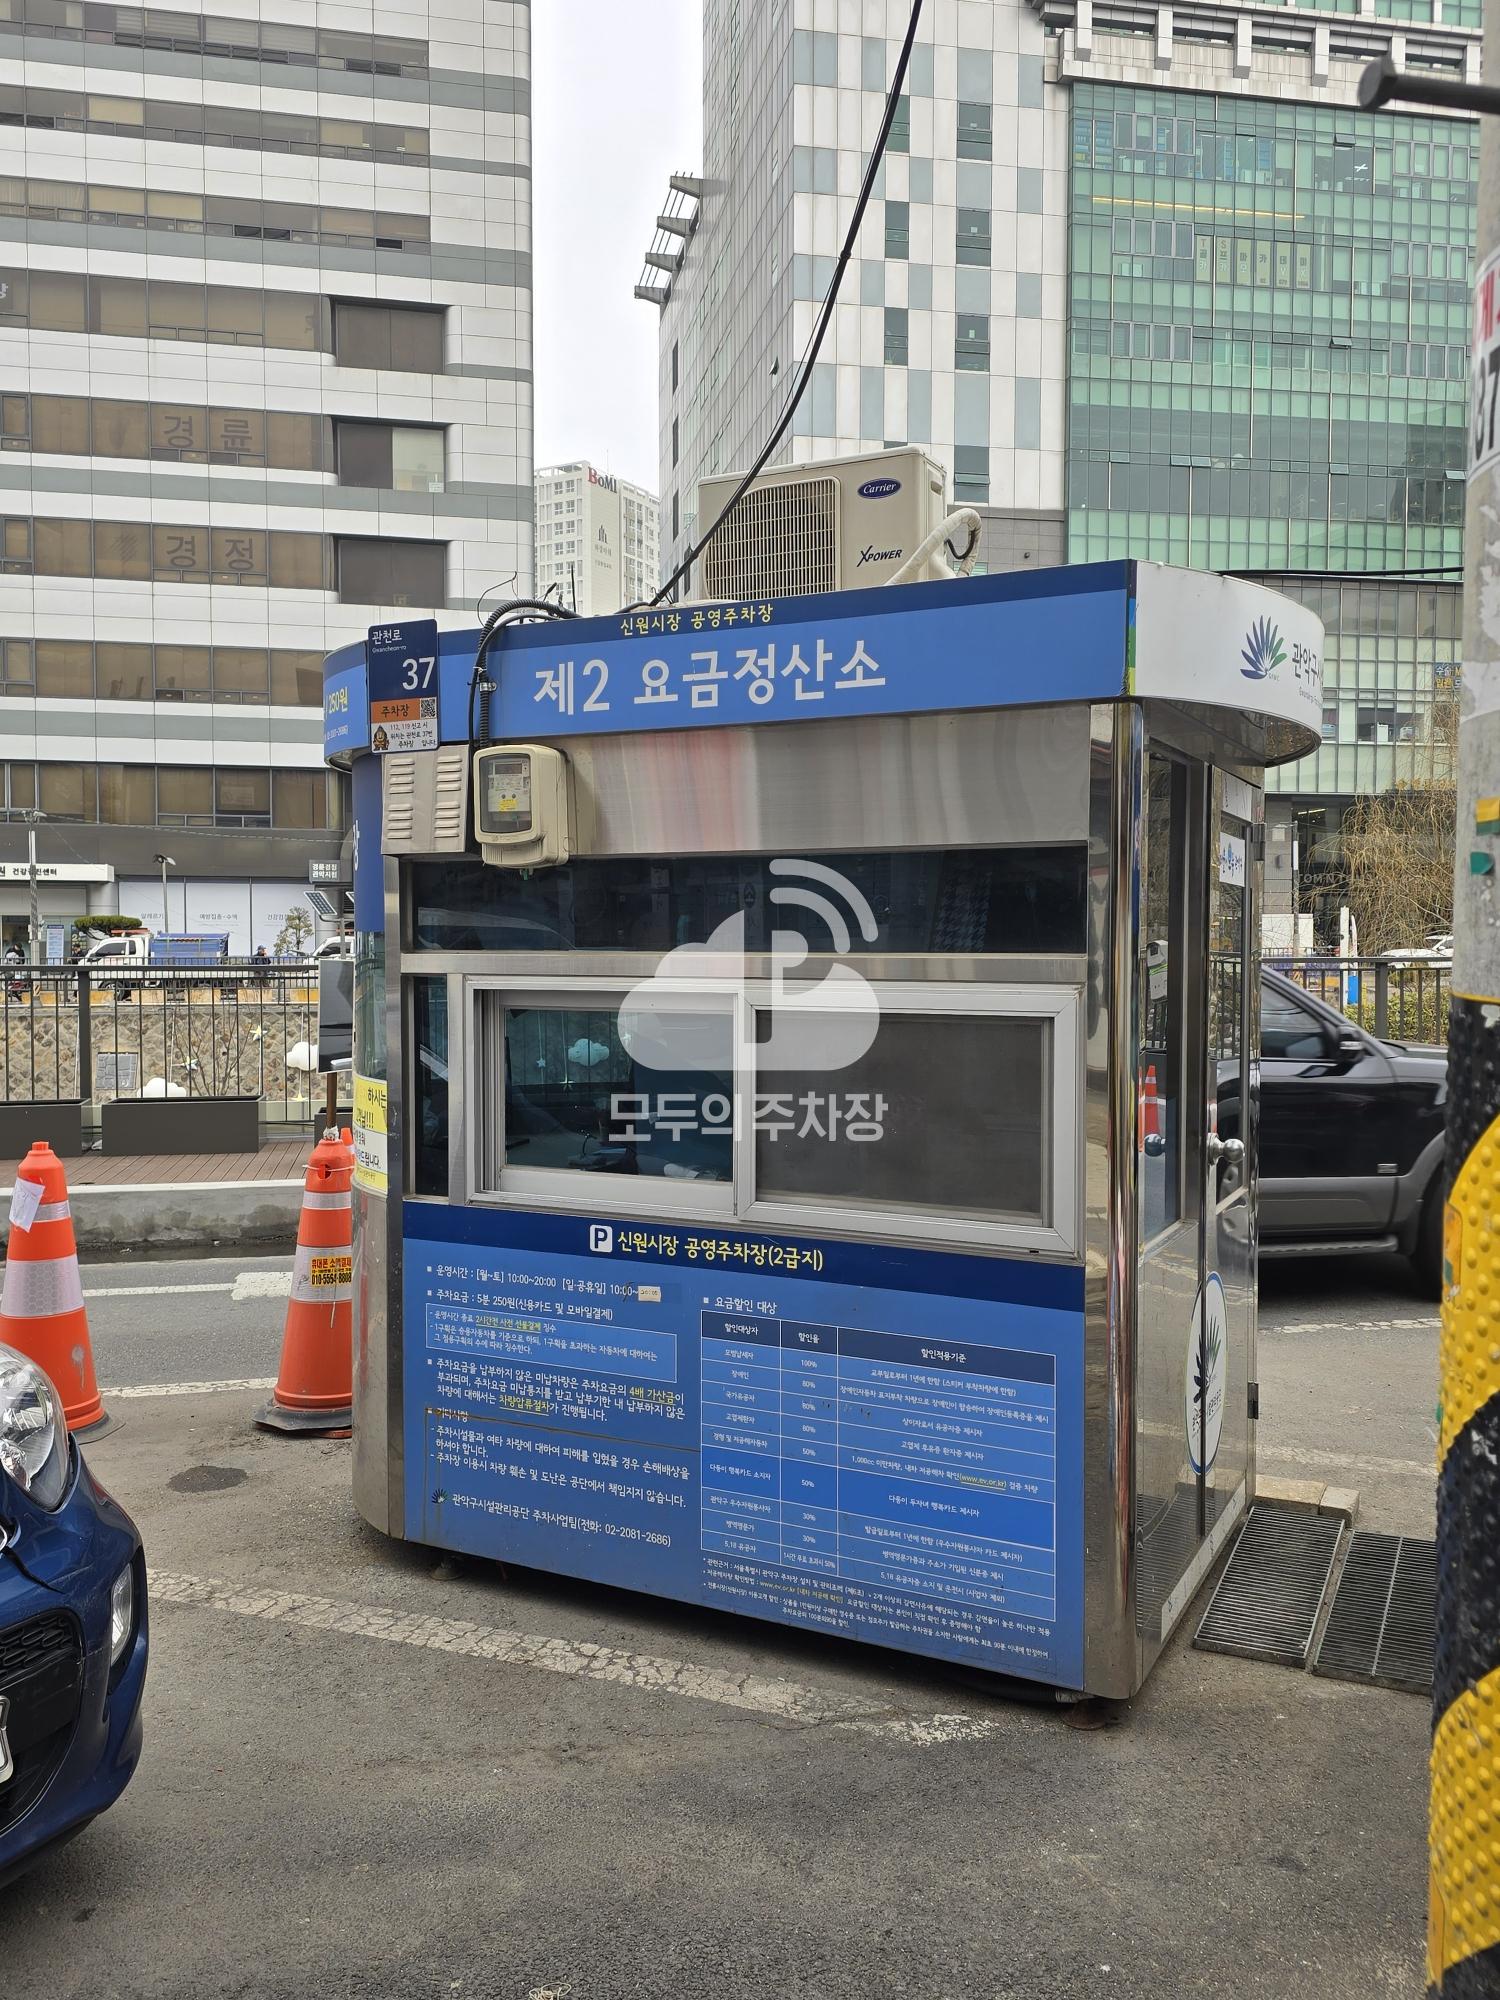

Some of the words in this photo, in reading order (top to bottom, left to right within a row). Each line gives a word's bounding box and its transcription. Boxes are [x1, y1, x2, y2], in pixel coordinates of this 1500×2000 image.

[863, 483, 896, 494] Carrier
[620, 617, 681, 637] 신원시장
[690, 602, 774, 630] 공영주차장
[371, 629, 402, 645] 관천로
[402, 657, 435, 690] 37
[534, 659, 610, 715] 제2
[633, 638, 886, 707] 요금정산소
[381, 704, 410, 718] 주차장
[402, 722, 411, 730] 119
[13, 867, 57, 876] 건강진센터
[367, 1086, 387, 1109] 하시는
[618, 1230, 680, 1257] 신원시장
[684, 1235, 824, 1272] 공영주차장(2급지)
[436, 1265, 468, 1278] 운영시간
[477, 1269, 503, 1283] [월~토]
[508, 1273, 556, 1287] 10:00~20:00
[437, 1289, 469, 1303] 주차요금
[477, 1294, 490, 1305] 5분
[493, 1296, 552, 1312] 250원(신용카드
[555, 1303, 563, 1314] 및
[567, 1305, 612, 1320] 모바일결제)
[715, 1297, 752, 1312] 요금할인
[757, 1301, 777, 1314] 대상
[725, 1323, 758, 1335] 할인대상자
[799, 1333, 819, 1343] 할인율
[599, 1345, 627, 1357] 자동차에
[630, 1350, 657, 1361] 대하여는
[921, 1349, 966, 1363] 할인적용기준
[437, 1358, 477, 1374] 주차요금을
[480, 1365, 512, 1379] 납부하지
[516, 1370, 533, 1382] 않은
[536, 1373, 578, 1389] 미납차량은
[582, 1380, 626, 1396] 주차요금의
[630, 1387, 643, 1398] 4배
[648, 1389, 683, 1405] 가산금이
[732, 1370, 749, 1379] 장애인
[437, 1372, 470, 1387] 부과되며,
[474, 1377, 507, 1392] 주차요금
[511, 1383, 552, 1399] 미납통지를
[555, 1389, 572, 1401] 받고
[576, 1392, 611, 1408] 납부기한
[615, 1398, 623, 1409] 내
[627, 1400, 662, 1416] 납부하지
[666, 1406, 685, 1419] 않은
[438, 1385, 461, 1398] 차량에
[465, 1390, 496, 1404] 대해서는
[500, 1395, 558, 1413] 차량압류절차가
[562, 1405, 607, 1421] 진행됩니다.
[436, 1439, 460, 1452] 하셔야
[462, 1443, 488, 1457] 합니다.
[437, 1426, 484, 1443] 주차시설물과
[487, 1435, 503, 1447] 여타
[506, 1438, 531, 1452] 차량에
[535, 1443, 559, 1456] 대하여
[563, 1448, 589, 1462] 피해를
[593, 1452, 618, 1467] 입혔을
[622, 1457, 639, 1470] 경우
[643, 1461, 689, 1479] 손해배상을
[437, 1452, 460, 1466] 주차장
[464, 1457, 487, 1471] 이용시
[490, 1462, 507, 1475] 차량
[530, 1469, 537, 1481] 및
[541, 1472, 567, 1486] 도난은
[570, 1476, 604, 1493] 공단에서
[609, 1483, 643, 1500] 책임지지
[647, 1490, 685, 1507] 않습니다.
[889, 1495, 907, 1504] 다둥이
[452, 1494, 529, 1519] 관악구시설관리공단
[532, 1510, 601, 1533] 주차사업팀(전화:
[605, 1524, 670, 1547] 02-2081-2686)
